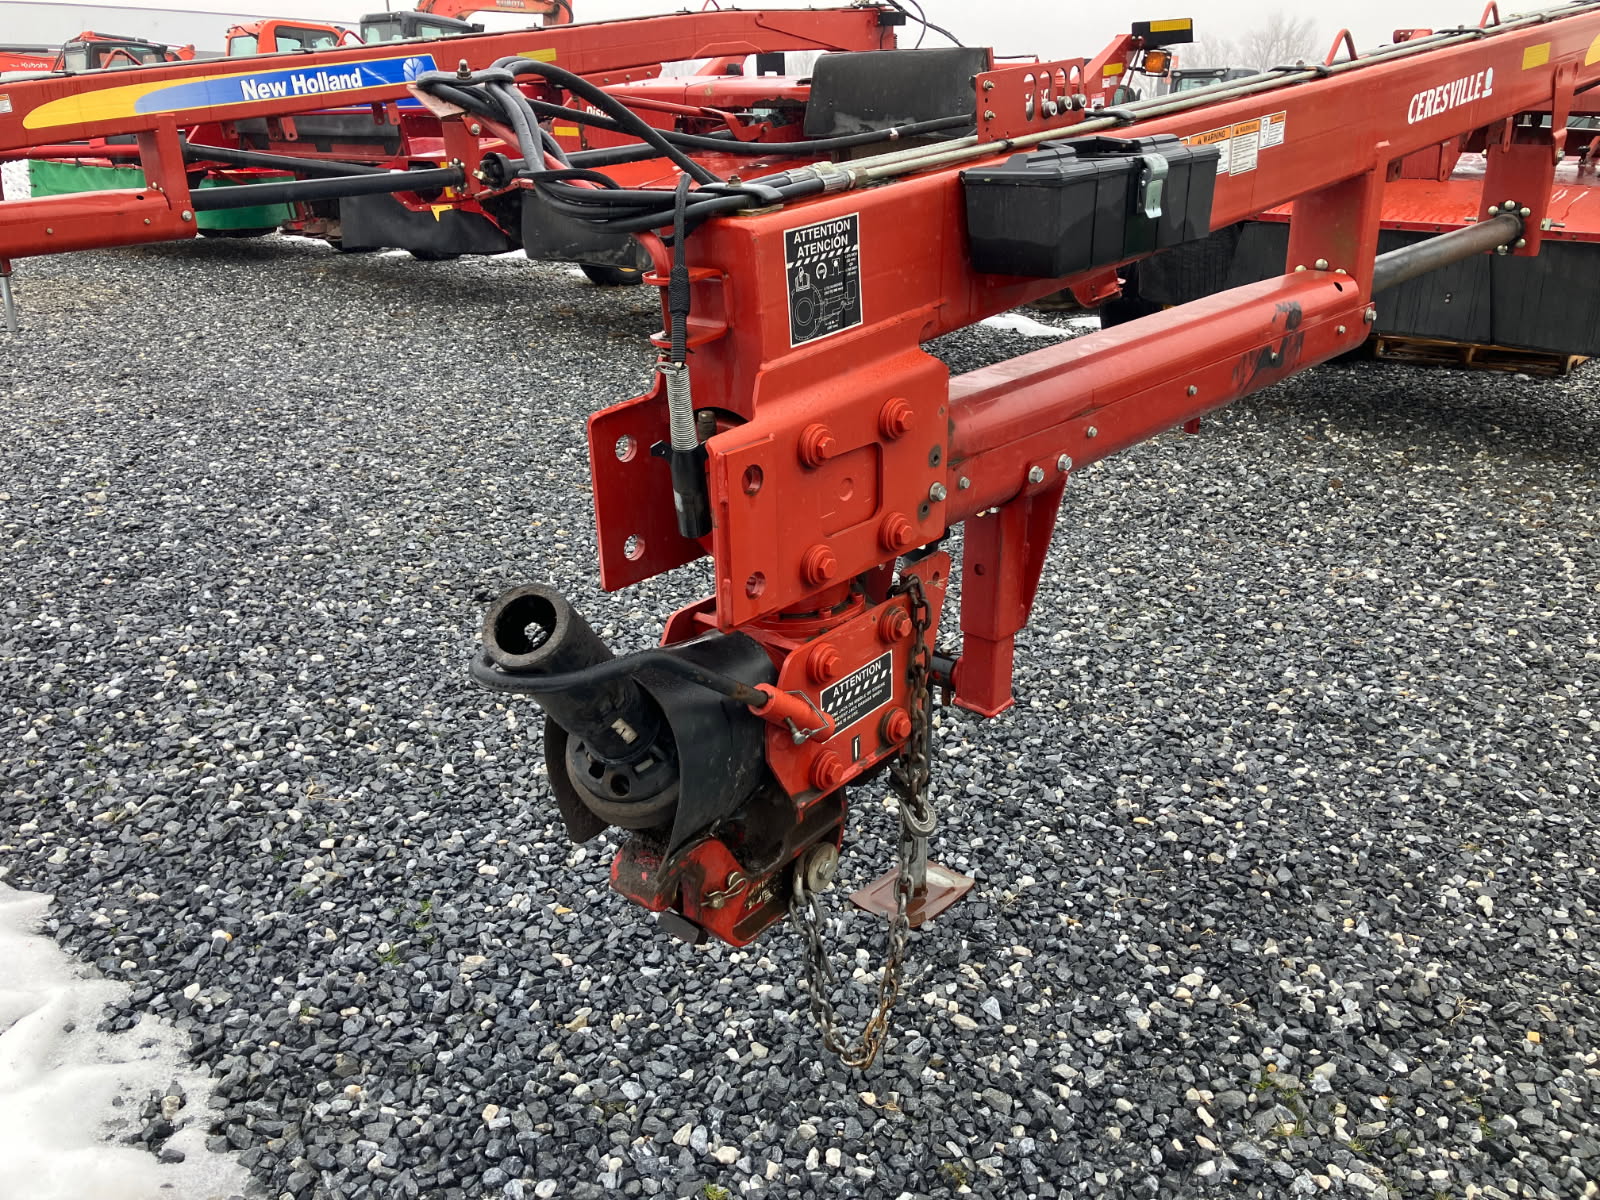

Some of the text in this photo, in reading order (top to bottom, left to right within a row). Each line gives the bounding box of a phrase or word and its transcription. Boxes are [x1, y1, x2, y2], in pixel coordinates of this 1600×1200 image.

[240, 67, 363, 101] New Holland
[1407, 71, 1484, 125] CERESVILLE
[794, 218, 851, 245] ATTENTION
[797, 232, 848, 259] ATENCIÓN
[833, 660, 882, 698] ATTENTION
